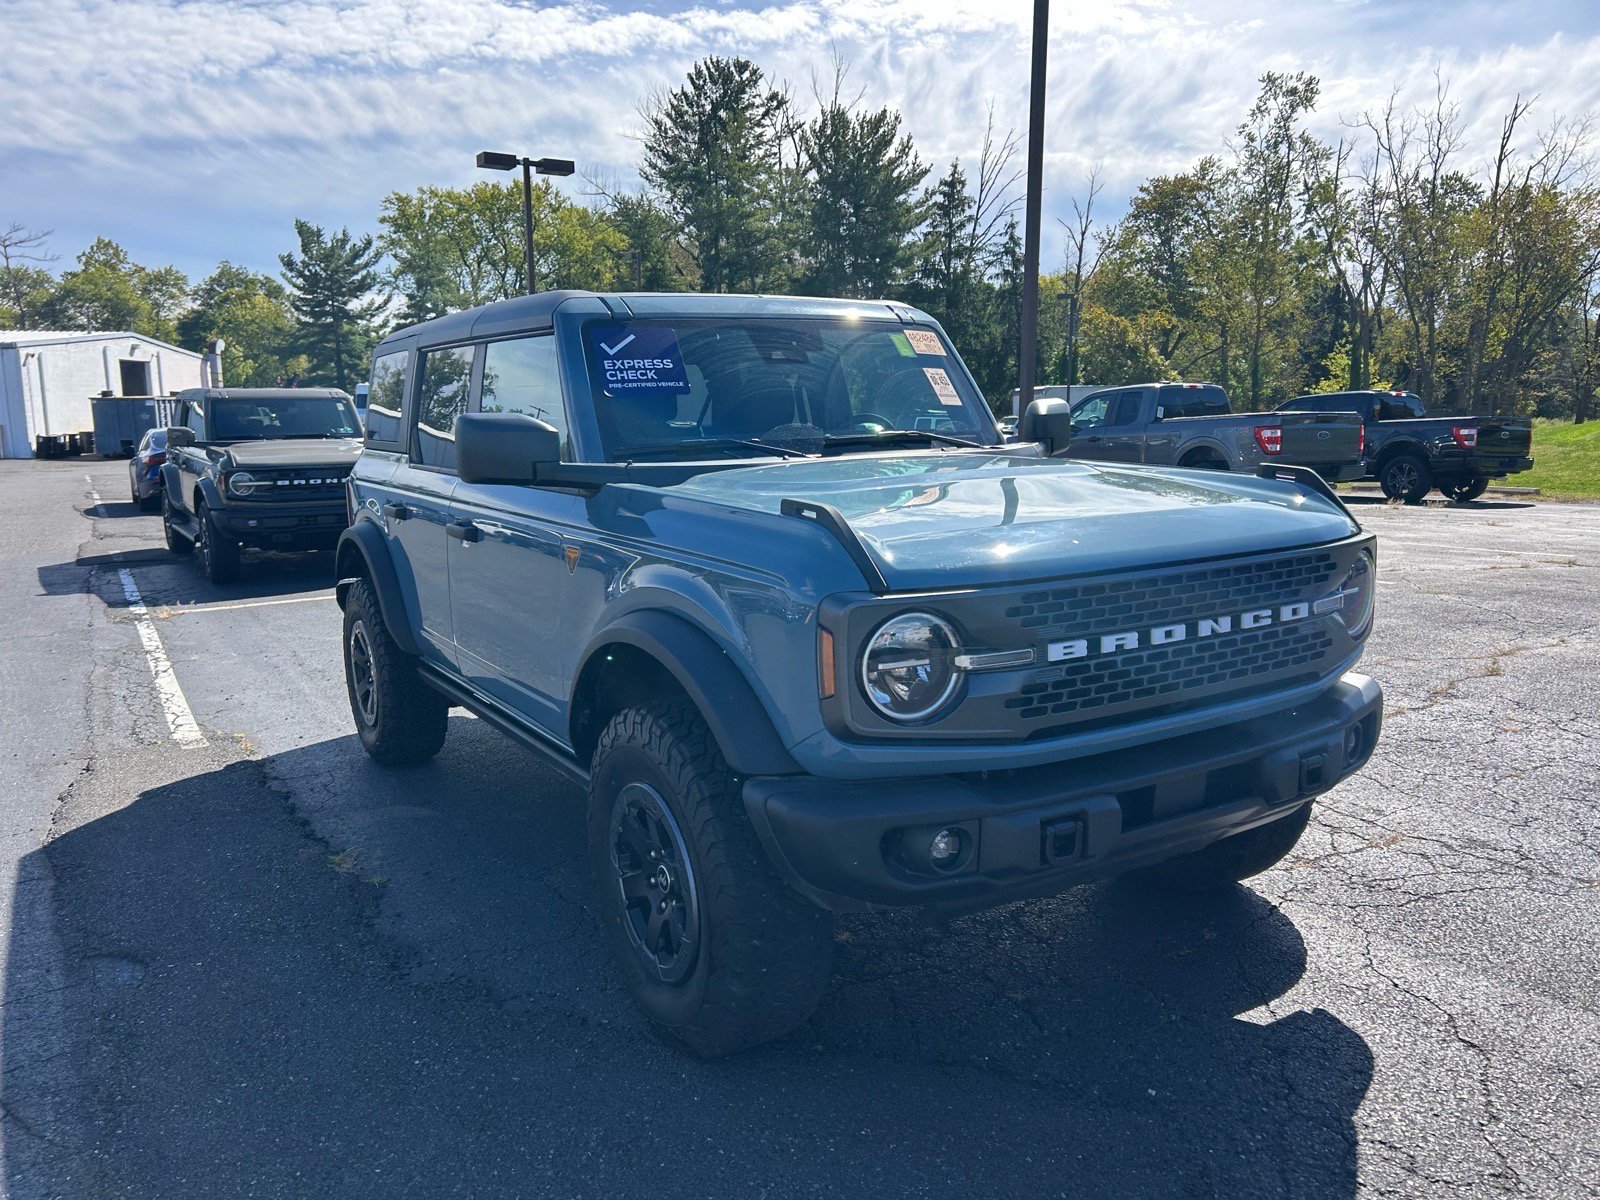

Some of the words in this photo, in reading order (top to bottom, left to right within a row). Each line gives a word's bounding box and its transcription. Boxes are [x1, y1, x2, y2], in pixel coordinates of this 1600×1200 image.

[603, 359, 673, 370] EXPRESS
[606, 370, 658, 380] CHECK
[1047, 602, 1309, 662] BRONCO
